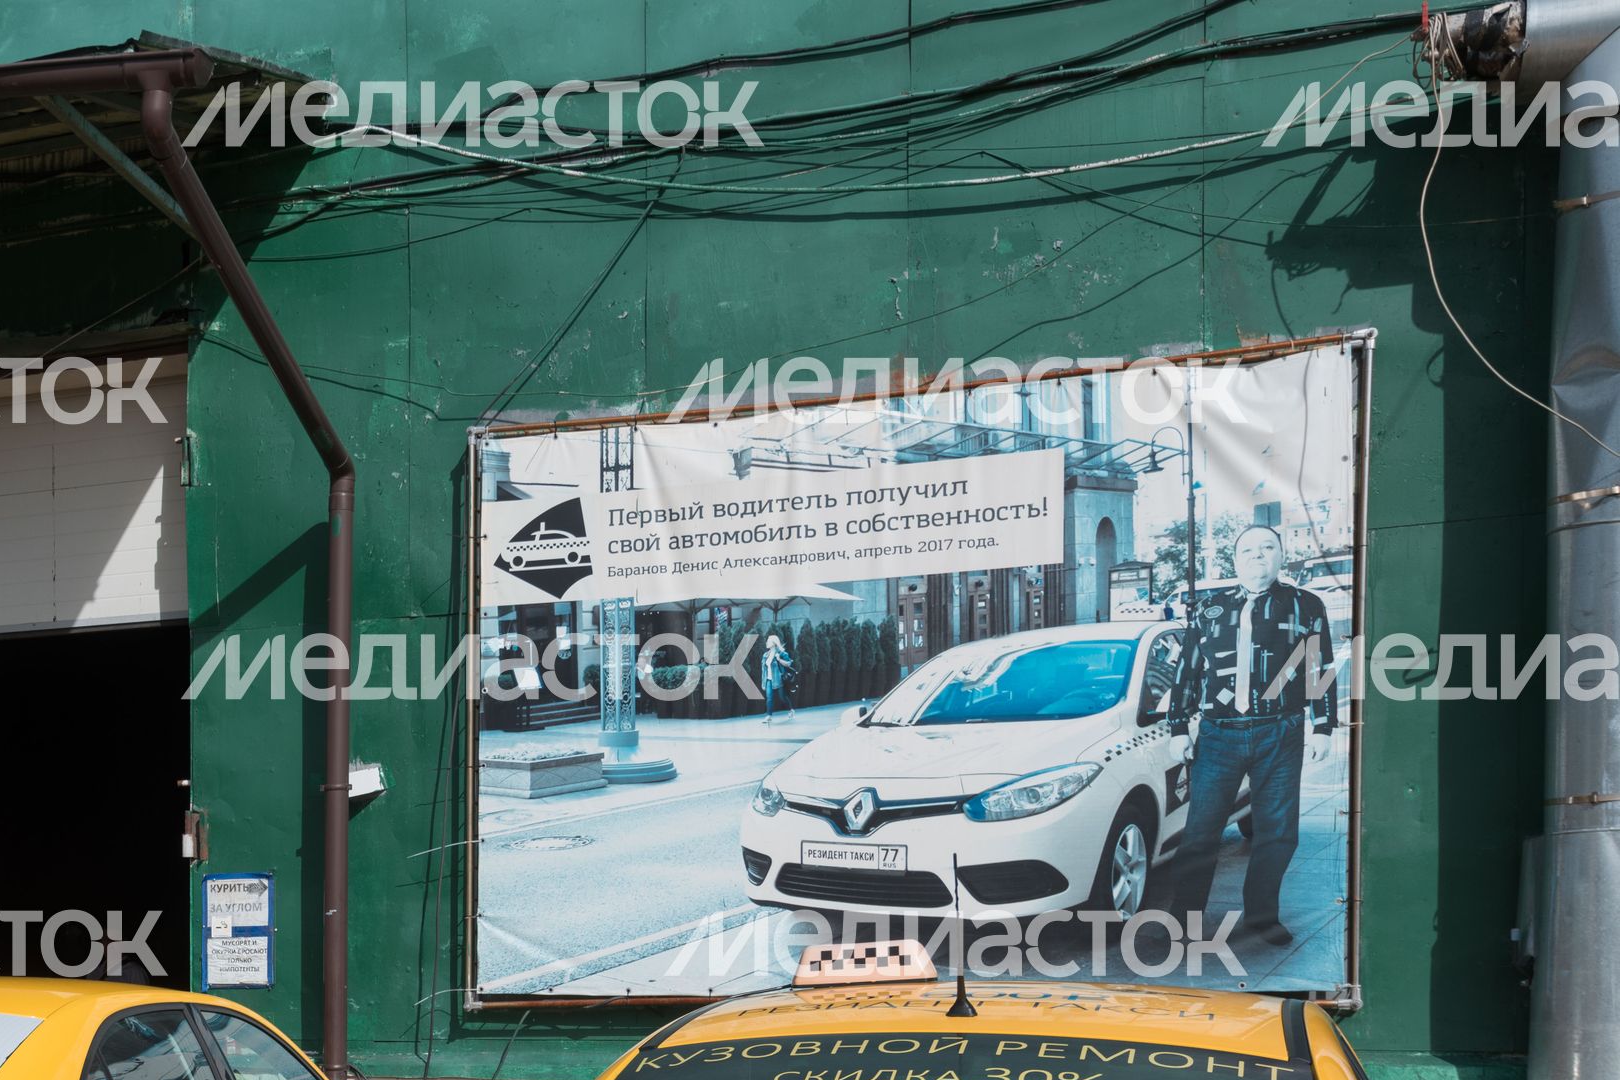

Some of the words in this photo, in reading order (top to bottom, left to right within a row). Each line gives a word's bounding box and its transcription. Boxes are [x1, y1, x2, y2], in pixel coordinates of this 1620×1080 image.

[608, 502, 704, 528] Первый
[713, 493, 838, 518] водитель
[846, 480, 968, 506] получил
[608, 534, 661, 554] свой
[668, 523, 817, 551] автомобиль
[825, 522, 838, 537] в
[846, 497, 1048, 535] собственность!
[607, 565, 668, 579] Баранов
[671, 560, 718, 575] Денис
[722, 551, 850, 570] Александрович,
[854, 544, 913, 559] апрель
[917, 538, 953, 553] 2017
[958, 535, 999, 549] года.
[807, 848, 848, 861] РЕЗИДЕНТ
[850, 851, 875, 862] ТАКСИ
[880, 848, 899, 862] 77
[210, 883, 248, 893] КУРИТЬ
[210, 903, 222, 913] ЗА
[225, 903, 262, 912] УГЛОМ
[635, 1037, 969, 1073] КУЗОВНОЙ
